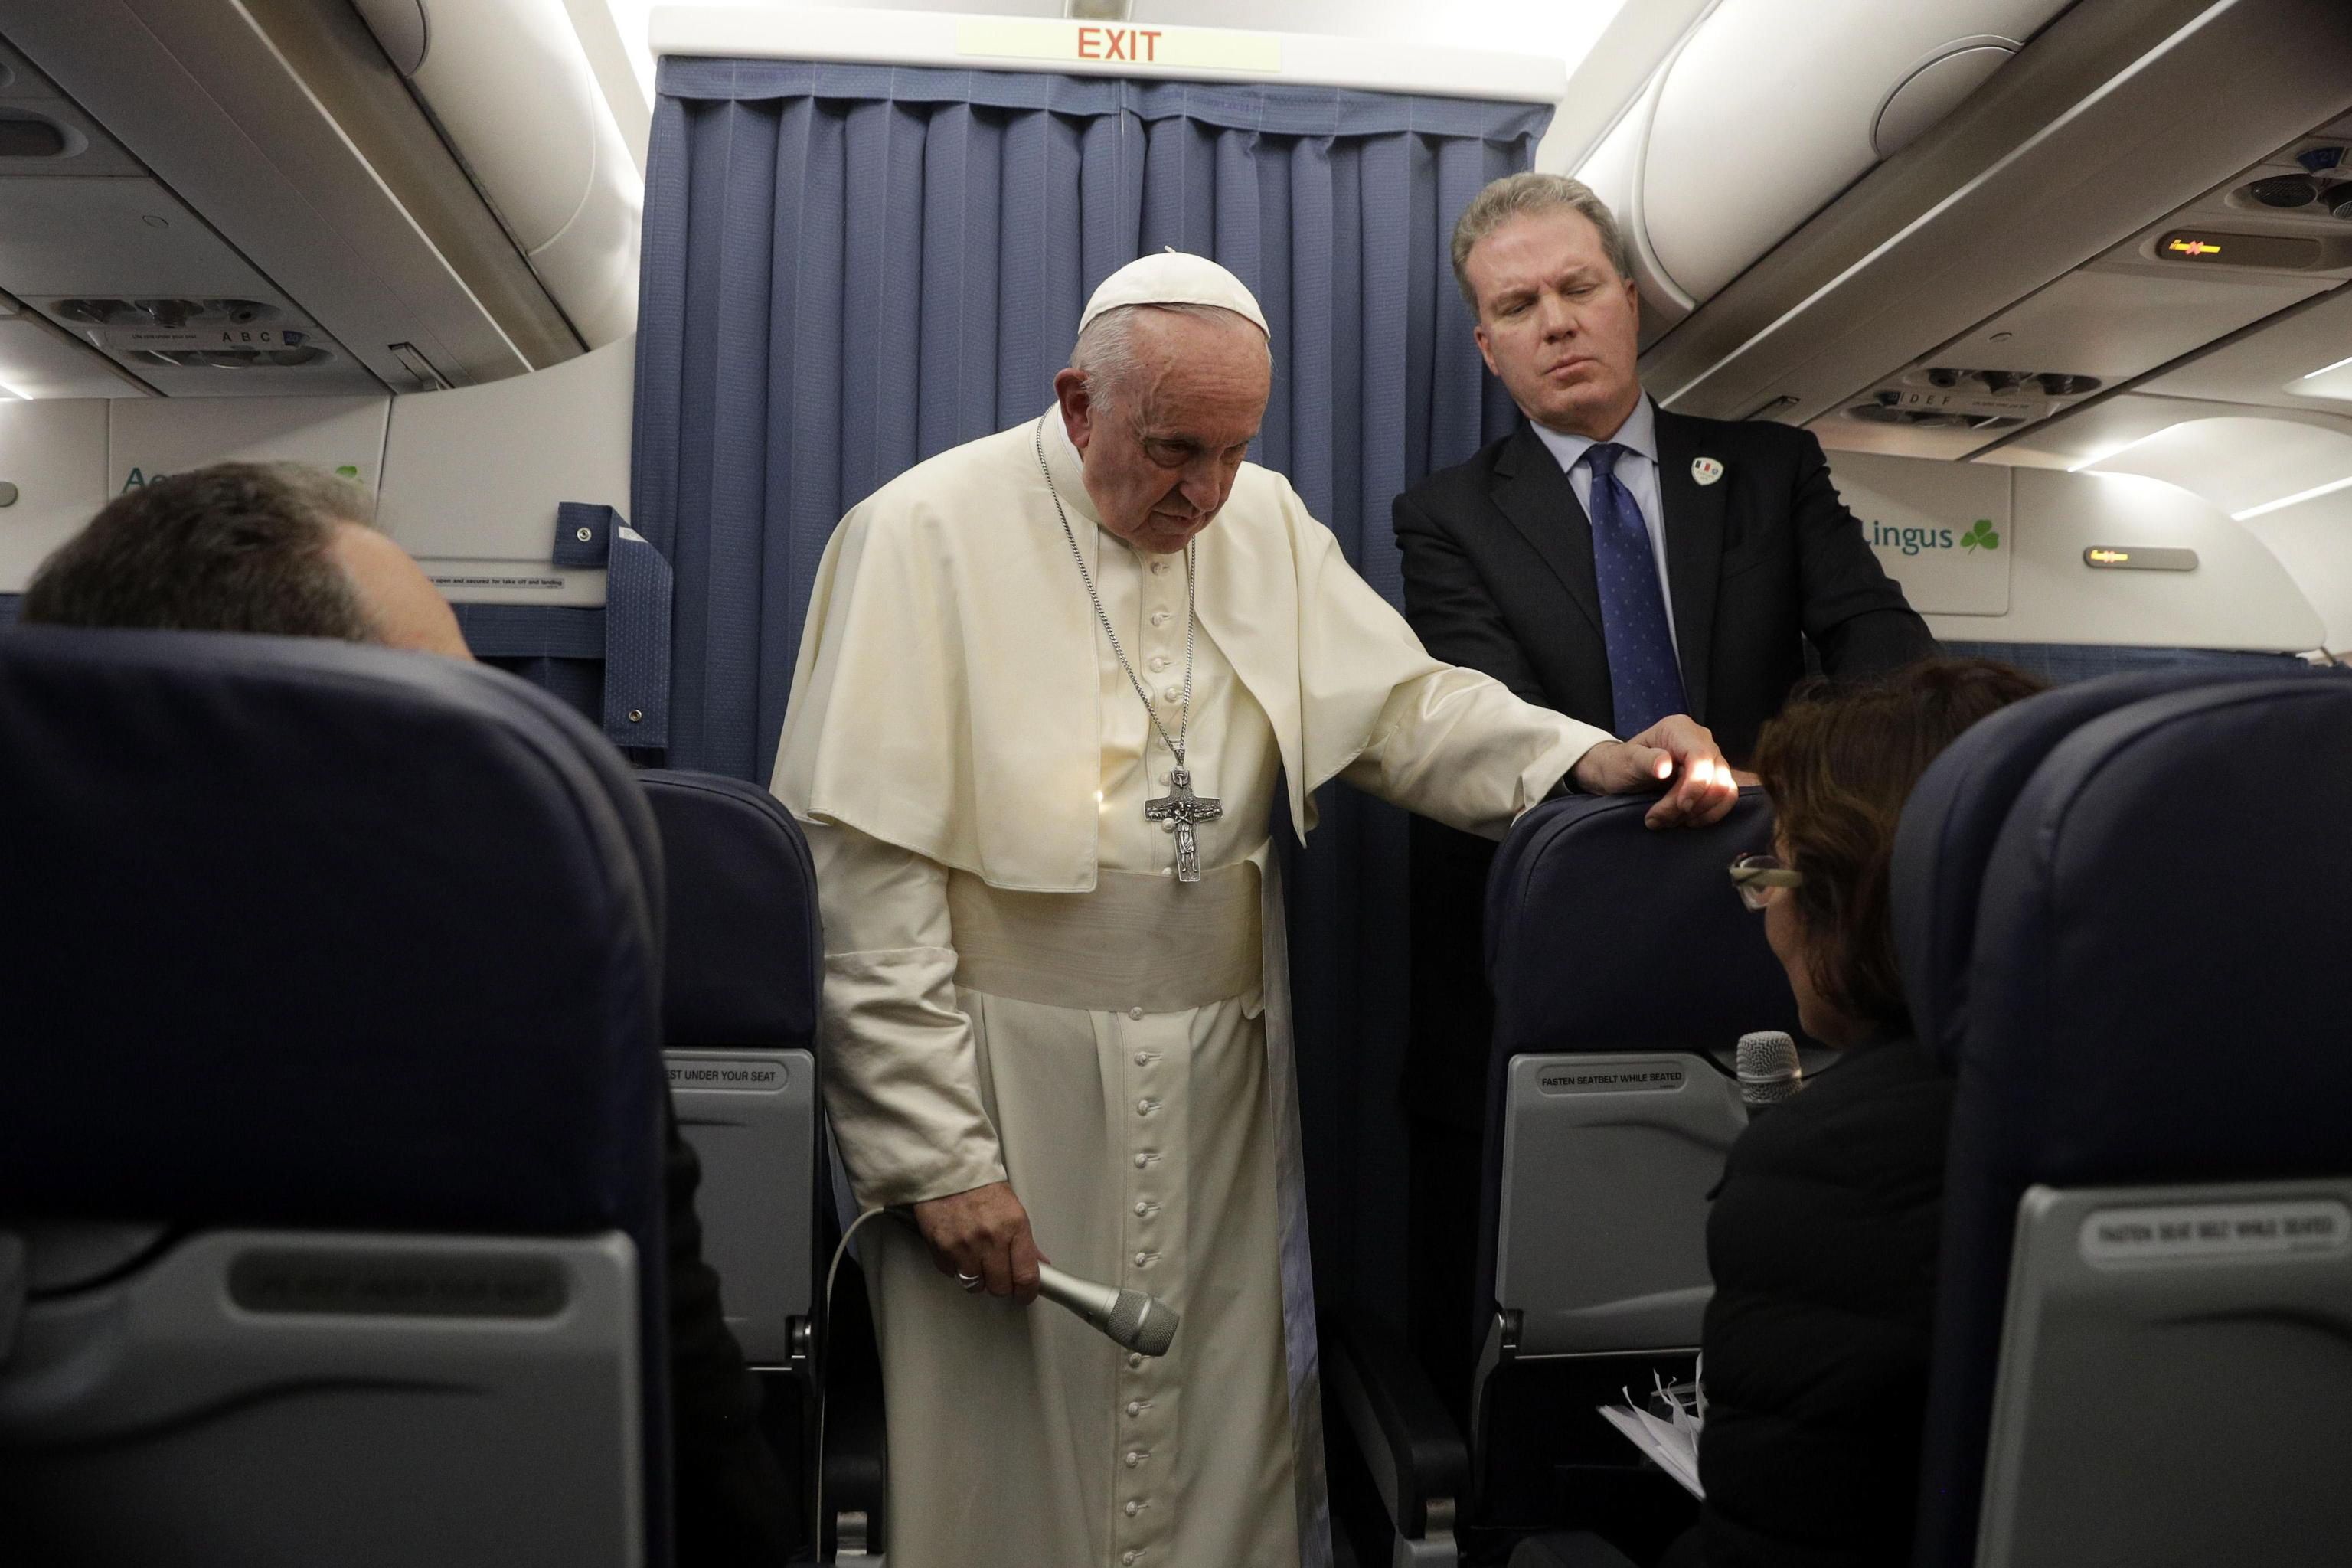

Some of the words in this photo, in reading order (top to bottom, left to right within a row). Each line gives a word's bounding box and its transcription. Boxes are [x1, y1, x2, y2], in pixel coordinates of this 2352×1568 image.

[1078, 28, 1162, 61] EXIT
[222, 332, 232, 342] A
[241, 332, 252, 342] B
[260, 332, 270, 342] C
[1910, 394, 1919, 403] D
[1926, 395, 1936, 404] E
[1942, 396, 1952, 405] F
[1867, 520, 1953, 555] ingus
[684, 1070, 719, 1080] UNDER
[721, 1070, 749, 1081] YOUR
[751, 1071, 776, 1082] SEAT
[1542, 1077, 1575, 1086] FASTEN
[1576, 1075, 1618, 1085] SEATBELT
[1620, 1073, 1648, 1083] WHILE
[1649, 1072, 1682, 1082] SEATED
